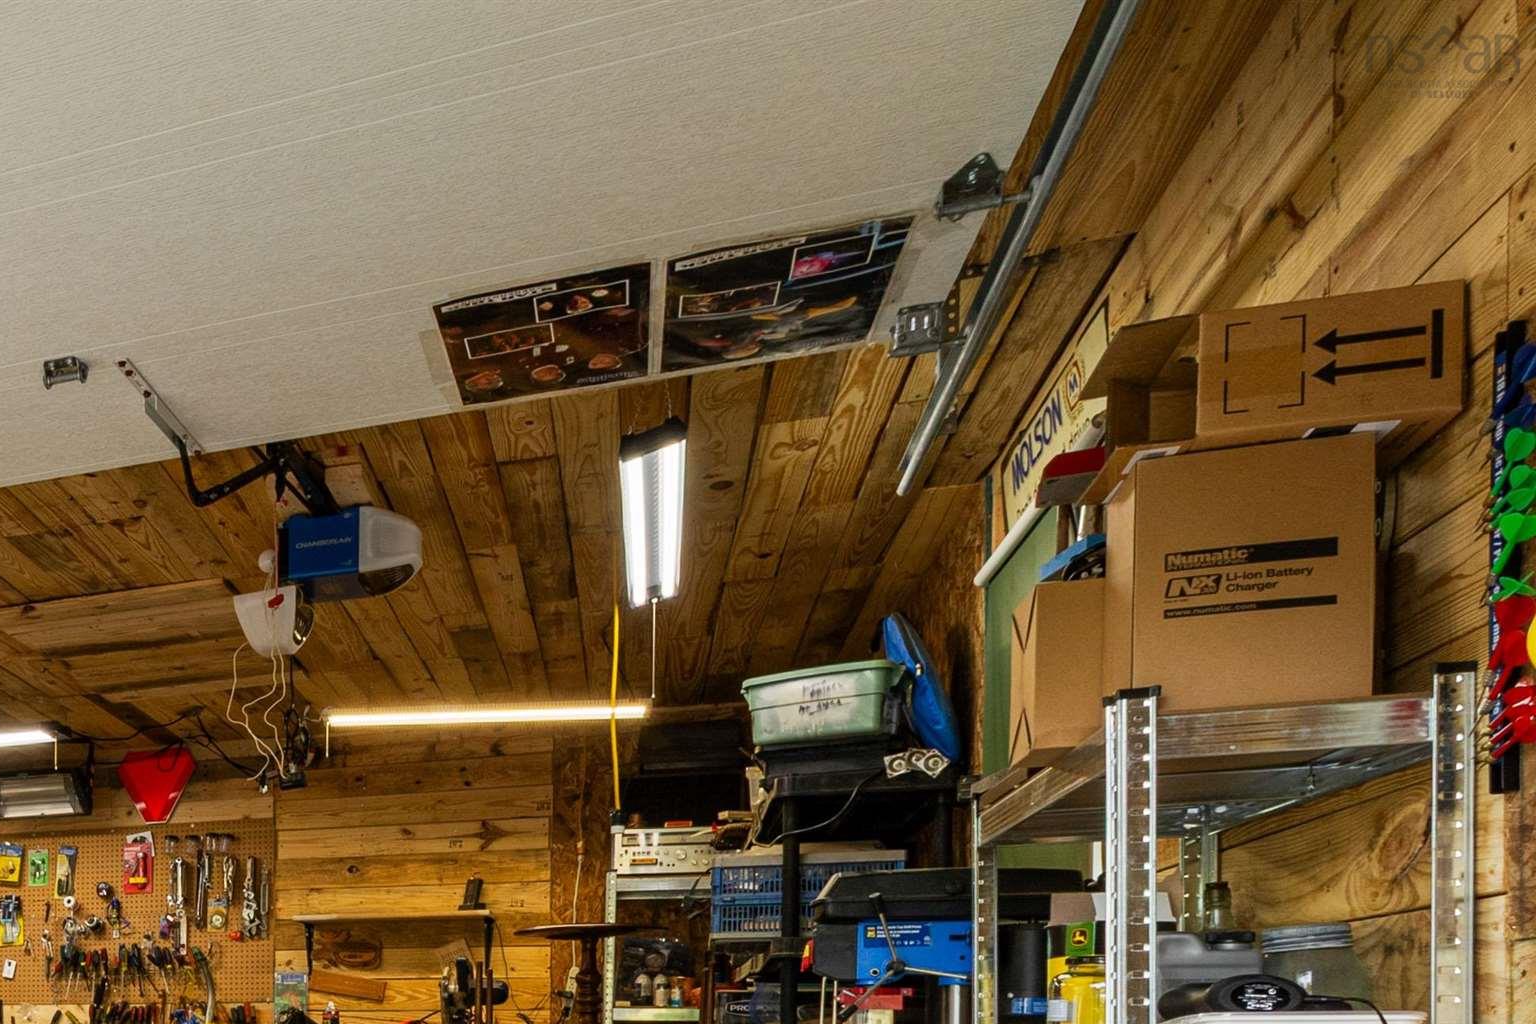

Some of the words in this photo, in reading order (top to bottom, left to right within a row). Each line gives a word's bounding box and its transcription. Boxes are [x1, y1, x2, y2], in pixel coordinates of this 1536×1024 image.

[1011, 389, 1063, 496] MOLSON
[1167, 548, 1248, 566] Numatic
[1226, 571, 1263, 581] Li-ion
[1266, 567, 1313, 579] Battery
[1226, 581, 1279, 593] Charger
[1167, 603, 1257, 616] www.numatic.com
